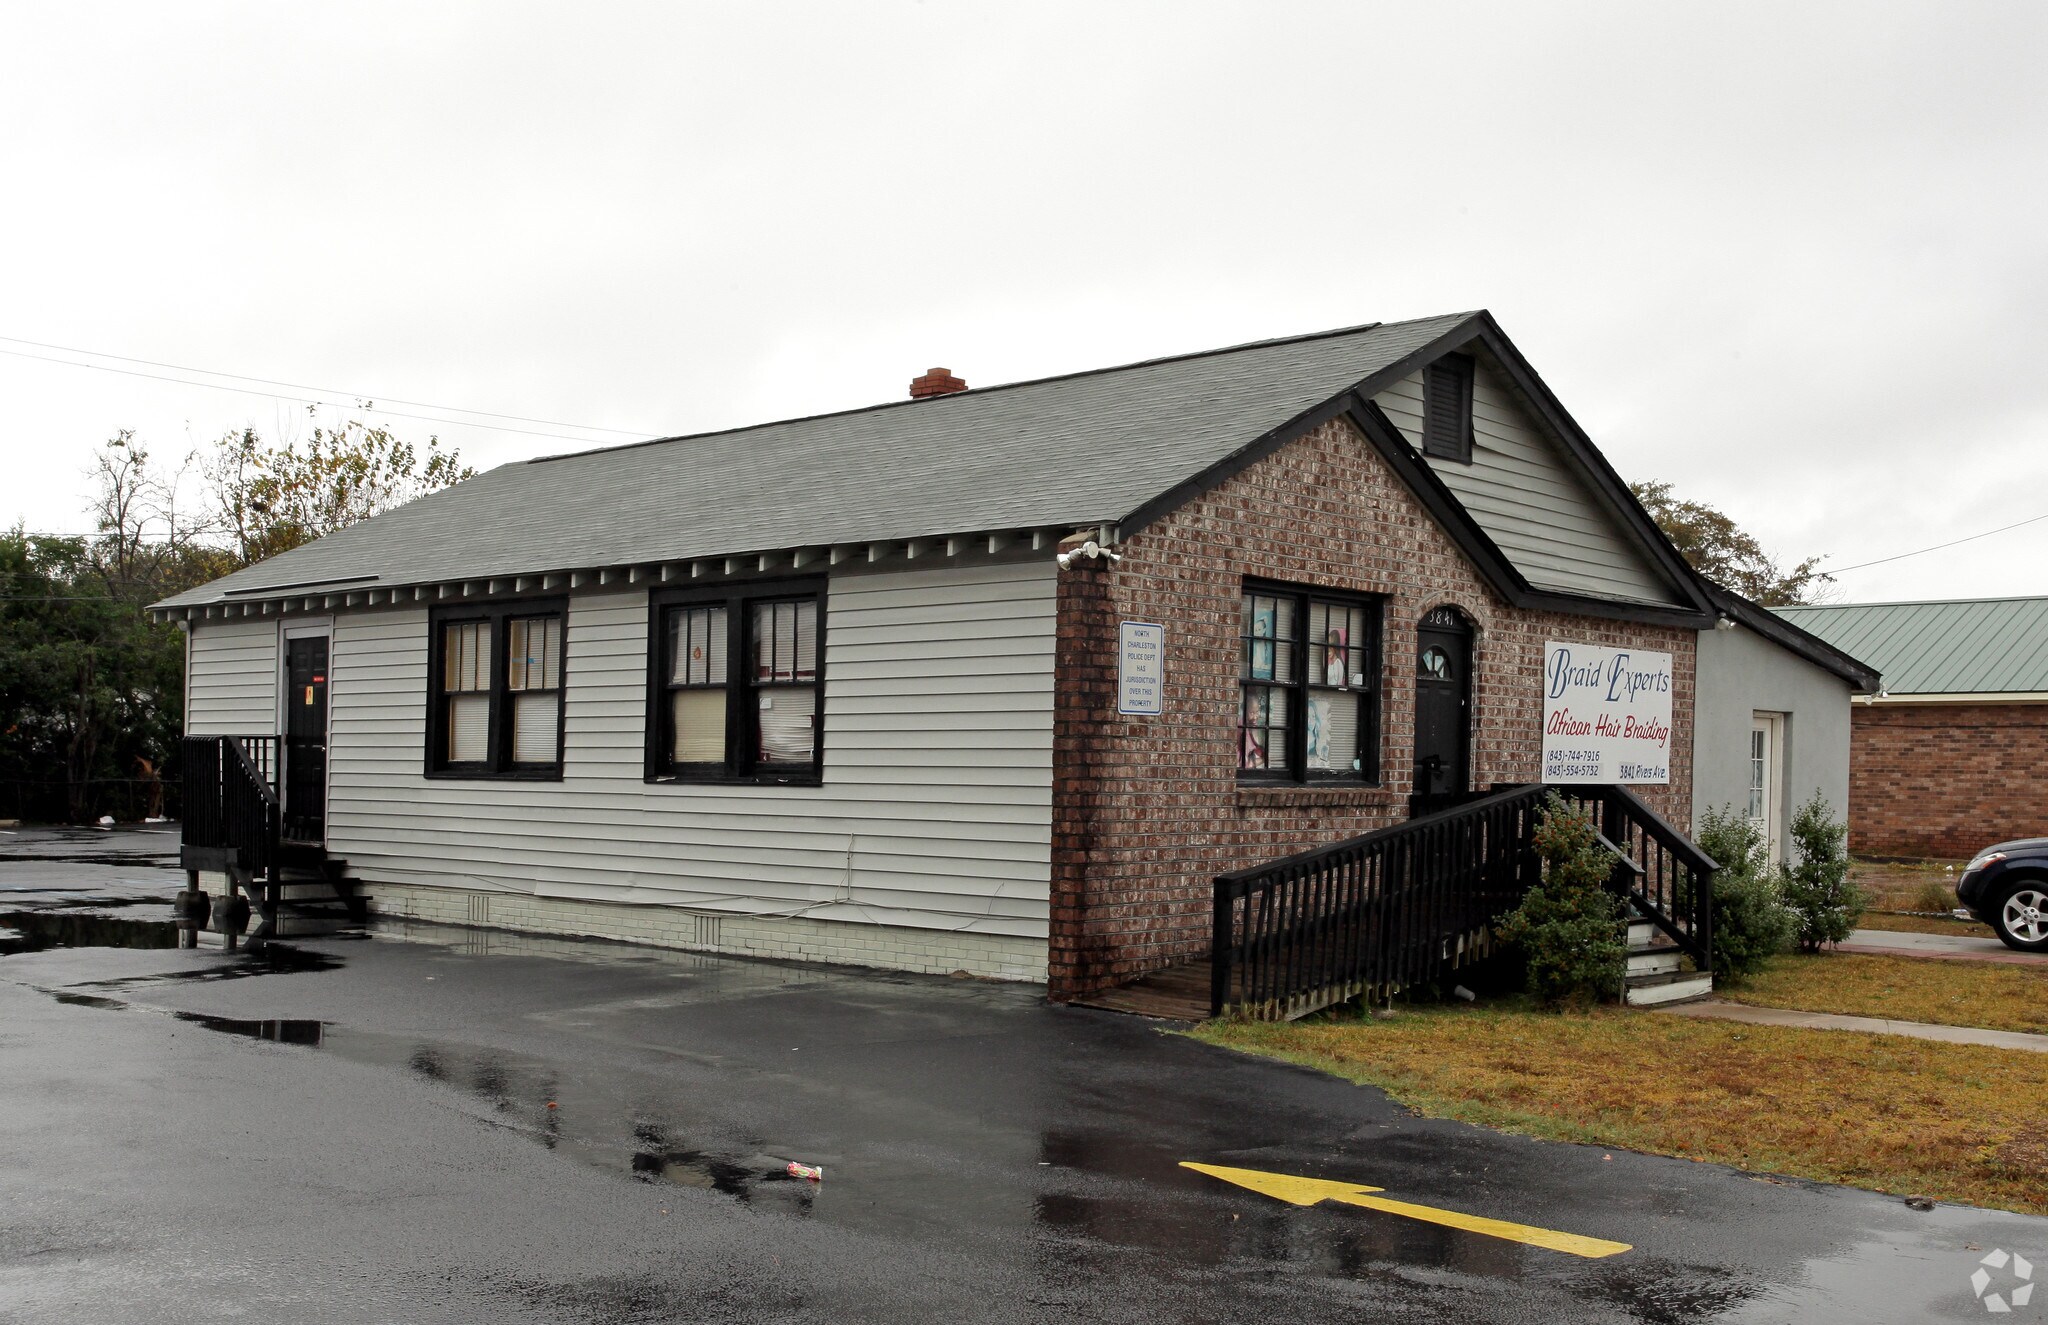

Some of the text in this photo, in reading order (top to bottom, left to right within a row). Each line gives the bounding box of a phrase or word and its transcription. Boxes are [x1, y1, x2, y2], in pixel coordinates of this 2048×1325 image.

[1429, 610, 1453, 626] 3841
[1127, 641, 1156, 650] CHARLESTON
[1128, 652, 1156, 661] POLICE DEPT
[1126, 676, 1156, 684] JURISDICTION
[1548, 648, 1670, 703] Braid Experts
[1142, 688, 1152, 696] THIS
[1129, 699, 1152, 707] PROPERTY
[1546, 707, 1669, 749] African Hair Braiding
[1546, 750, 1600, 763] (843)-744-7916
[1545, 763, 1599, 779] (843)-554-5732
[1619, 765, 1635, 779] 3841
[1635, 764, 1652, 778] Rivers
